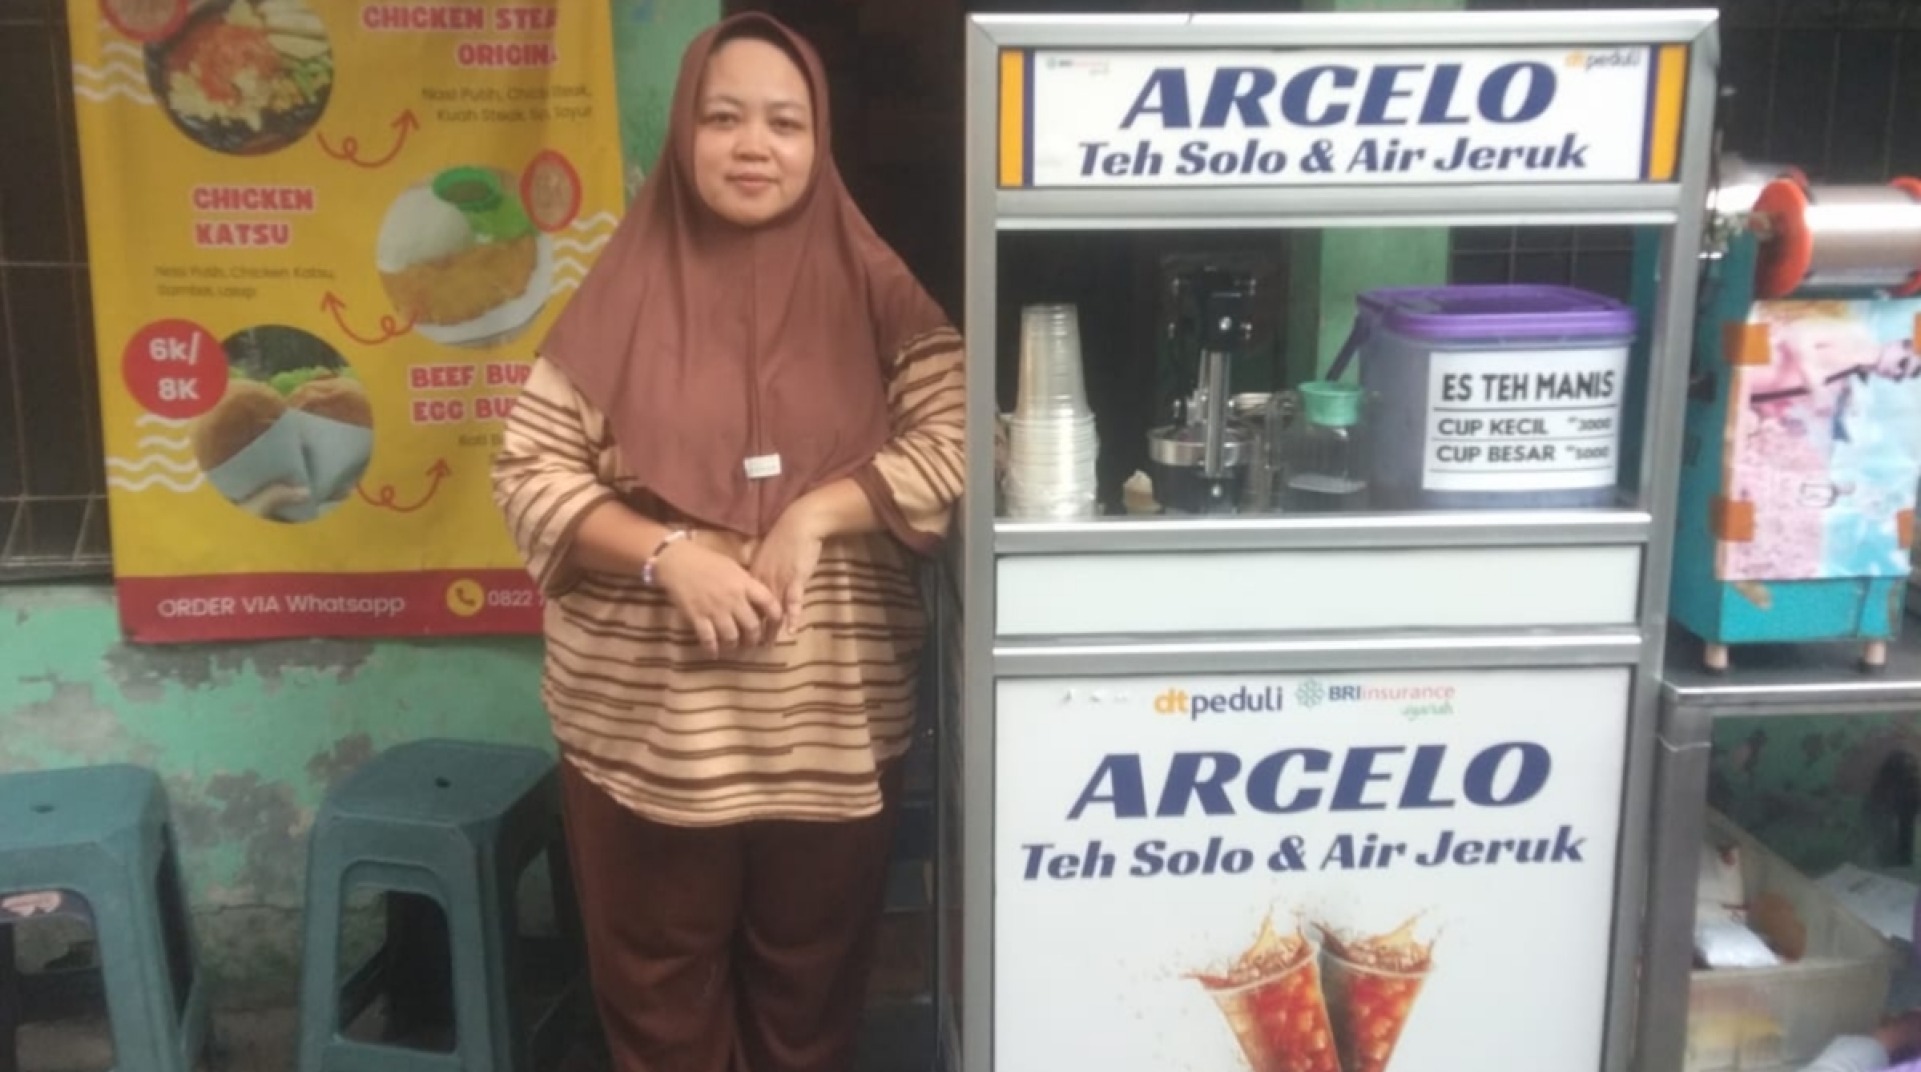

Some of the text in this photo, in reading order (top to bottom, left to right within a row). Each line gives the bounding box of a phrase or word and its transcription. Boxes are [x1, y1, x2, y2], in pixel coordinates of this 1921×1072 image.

[362, 5, 485, 30] CHICKEN
[457, 43, 557, 67] ORIGIN
[1119, 61, 1557, 129] ARCELO
[1078, 131, 1591, 177] Teh Solo & Air Jeruk
[192, 186, 314, 212] CHICKEN
[195, 222, 290, 246] KATSU
[149, 332, 200, 366] 6k/
[158, 378, 199, 401] 8K
[410, 365, 475, 389] BEEF
[1442, 370, 1615, 401] ES TEH MANIS
[413, 399, 464, 422] EGG
[1437, 418, 1482, 436] CUP
[1489, 417, 1549, 436] KECIL
[1436, 445, 1481, 463] CUP
[1487, 444, 1556, 463] BESAR
[157, 593, 405, 619] ORDER VIA Whatsapp
[487, 589, 533, 607] 0822
[1153, 685, 1284, 721] dtpeduli
[1065, 740, 1553, 820] ARCELO
[1021, 825, 1588, 881] Teh Solo & Air Jeruk
